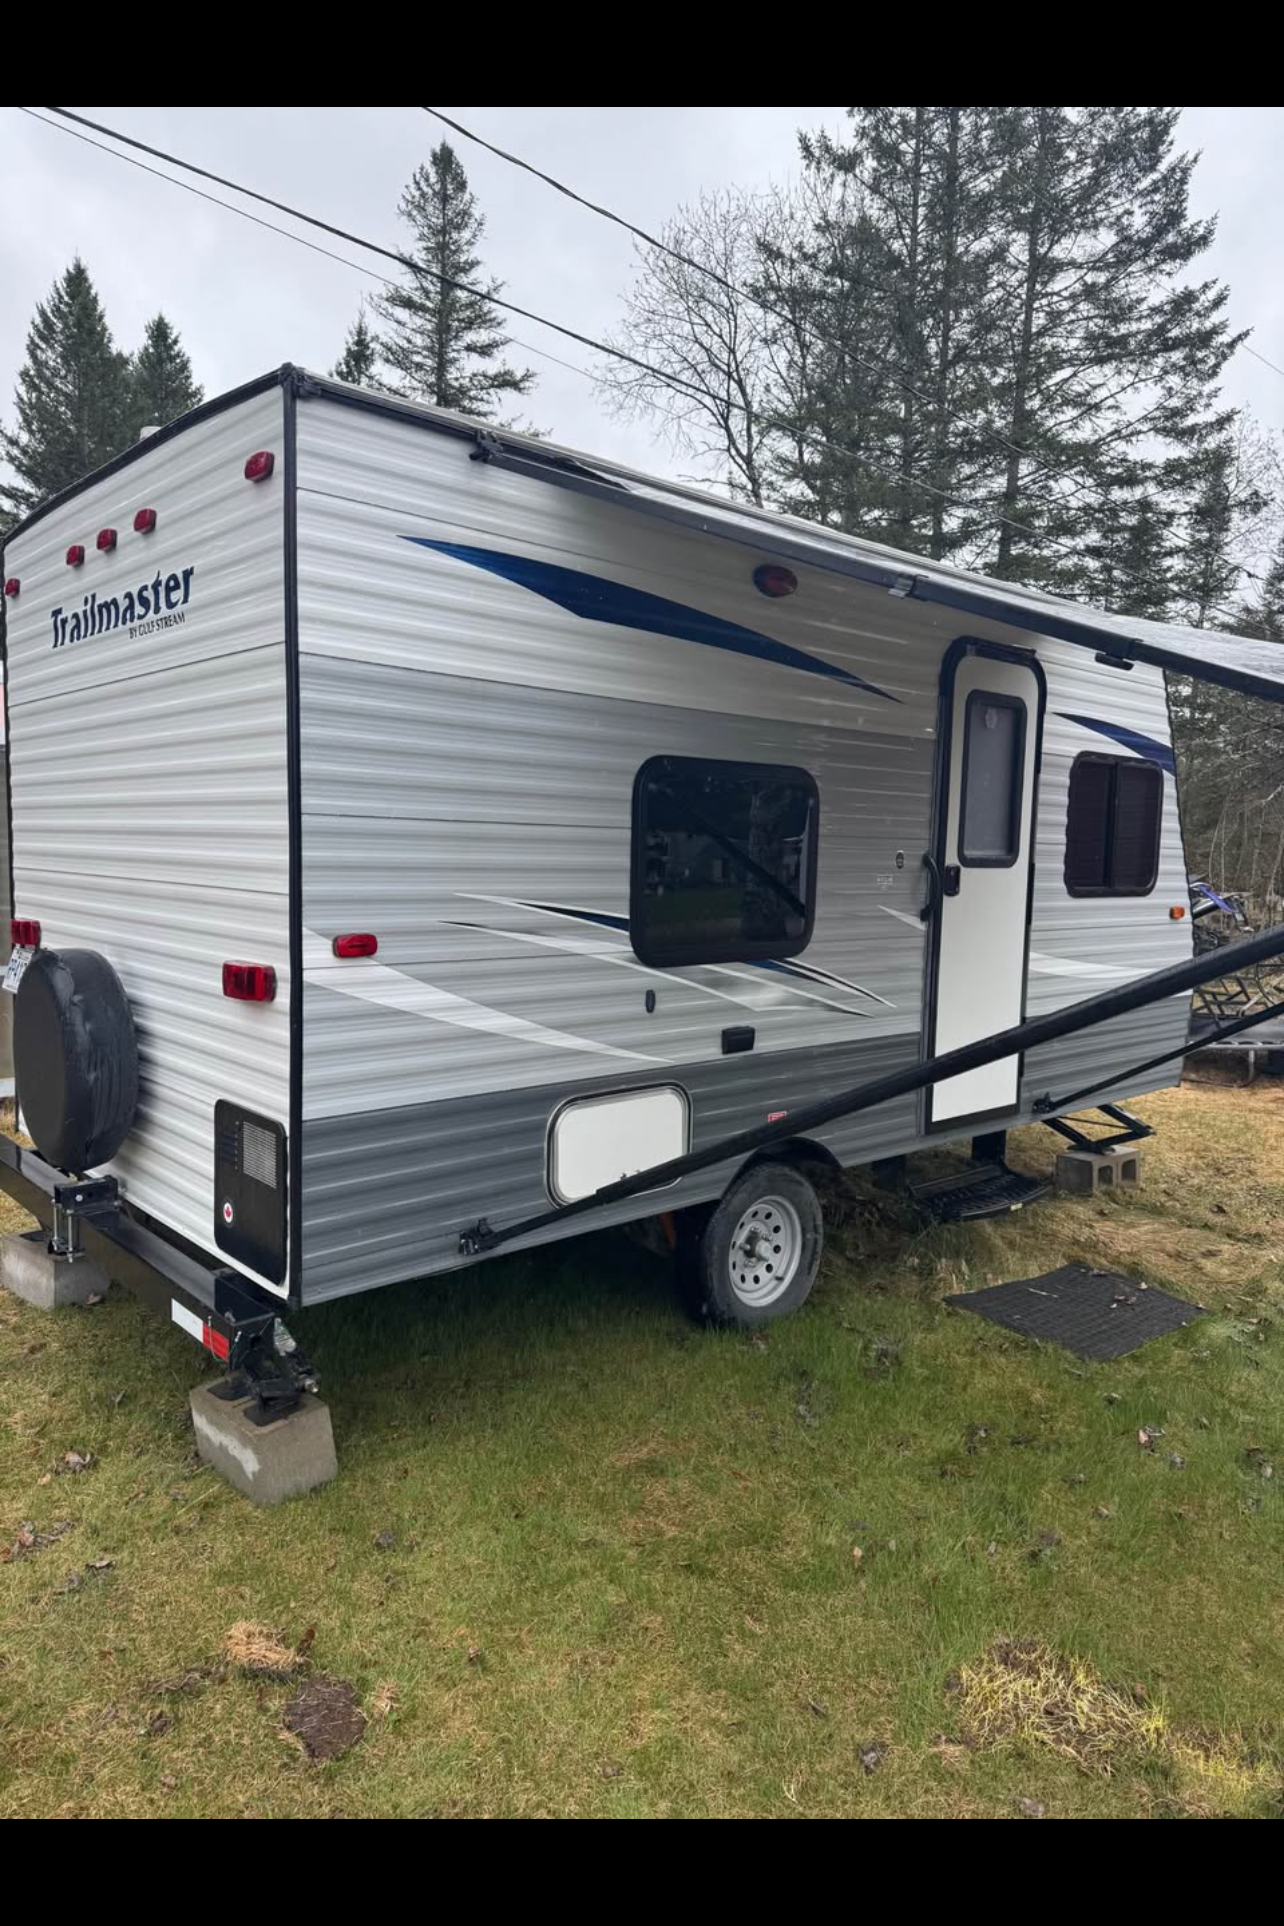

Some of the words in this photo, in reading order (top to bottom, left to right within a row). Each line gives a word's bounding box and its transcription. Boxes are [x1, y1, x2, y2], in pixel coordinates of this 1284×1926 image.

[51, 566, 195, 649] Trailmaster
[128, 626, 138, 640] BY
[138, 620, 155, 636] GULF
[155, 611, 186, 631] STREAM
